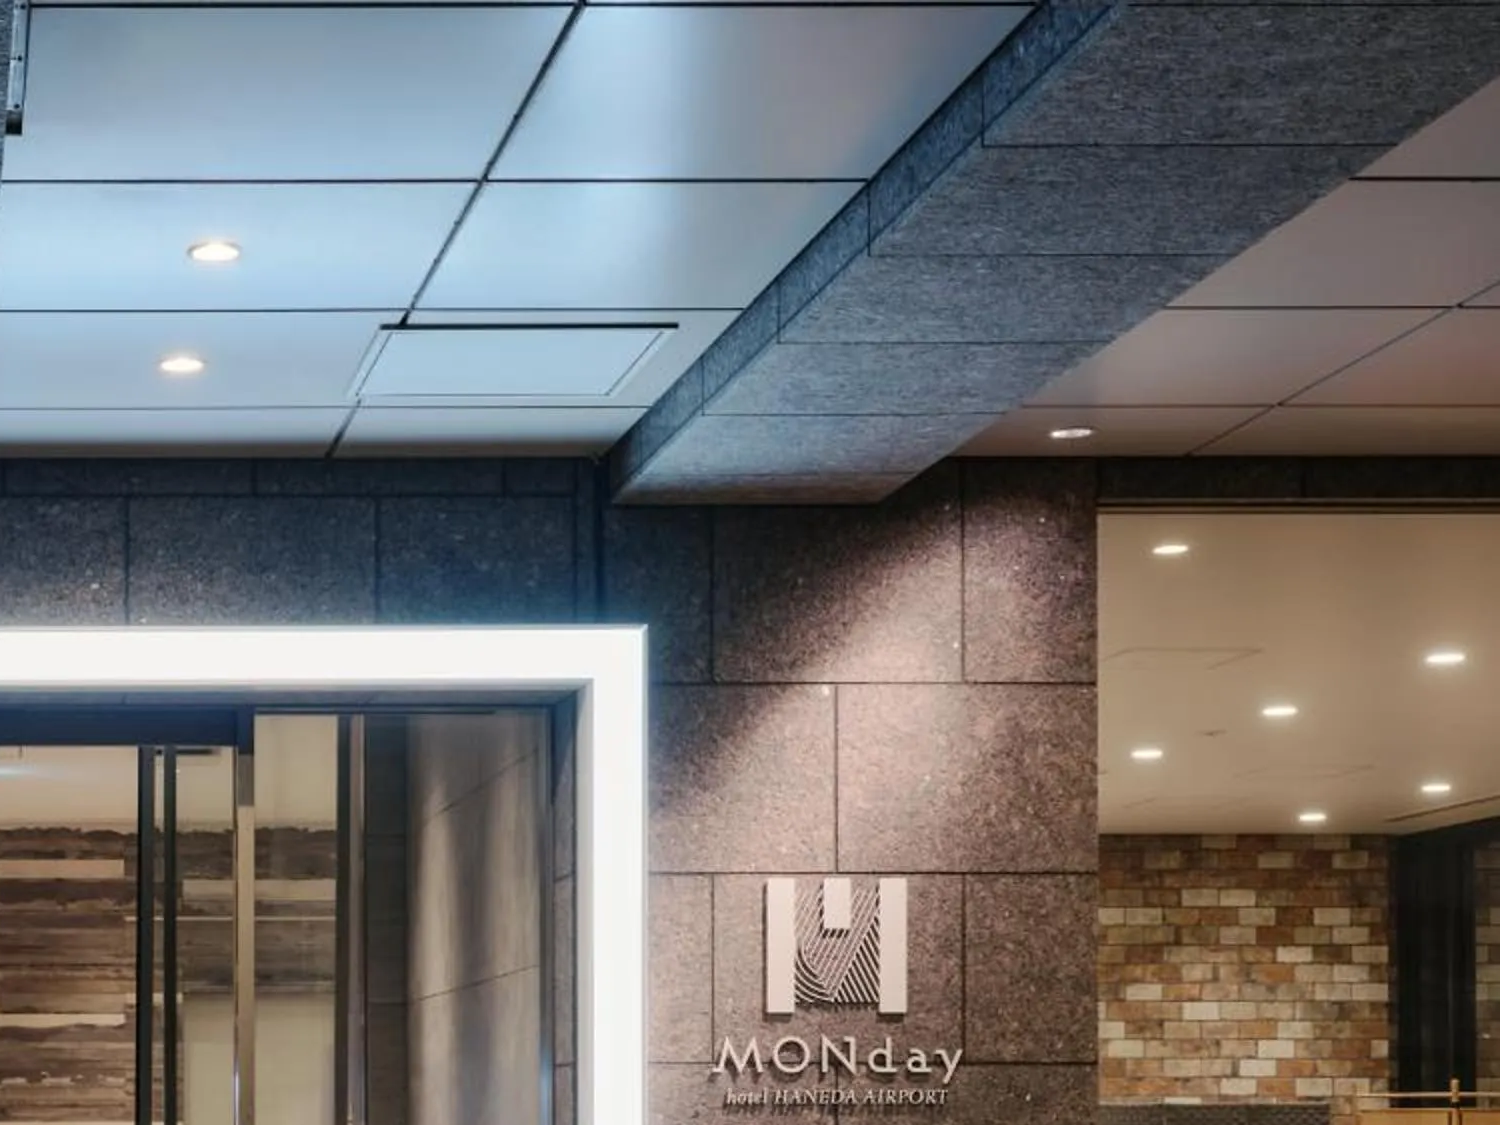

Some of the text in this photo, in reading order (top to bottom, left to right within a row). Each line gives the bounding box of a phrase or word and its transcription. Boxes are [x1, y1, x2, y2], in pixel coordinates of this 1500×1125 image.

[712, 1034, 963, 1084] MONday
[727, 1087, 948, 1105] hotel HANEDA AIRPORT
